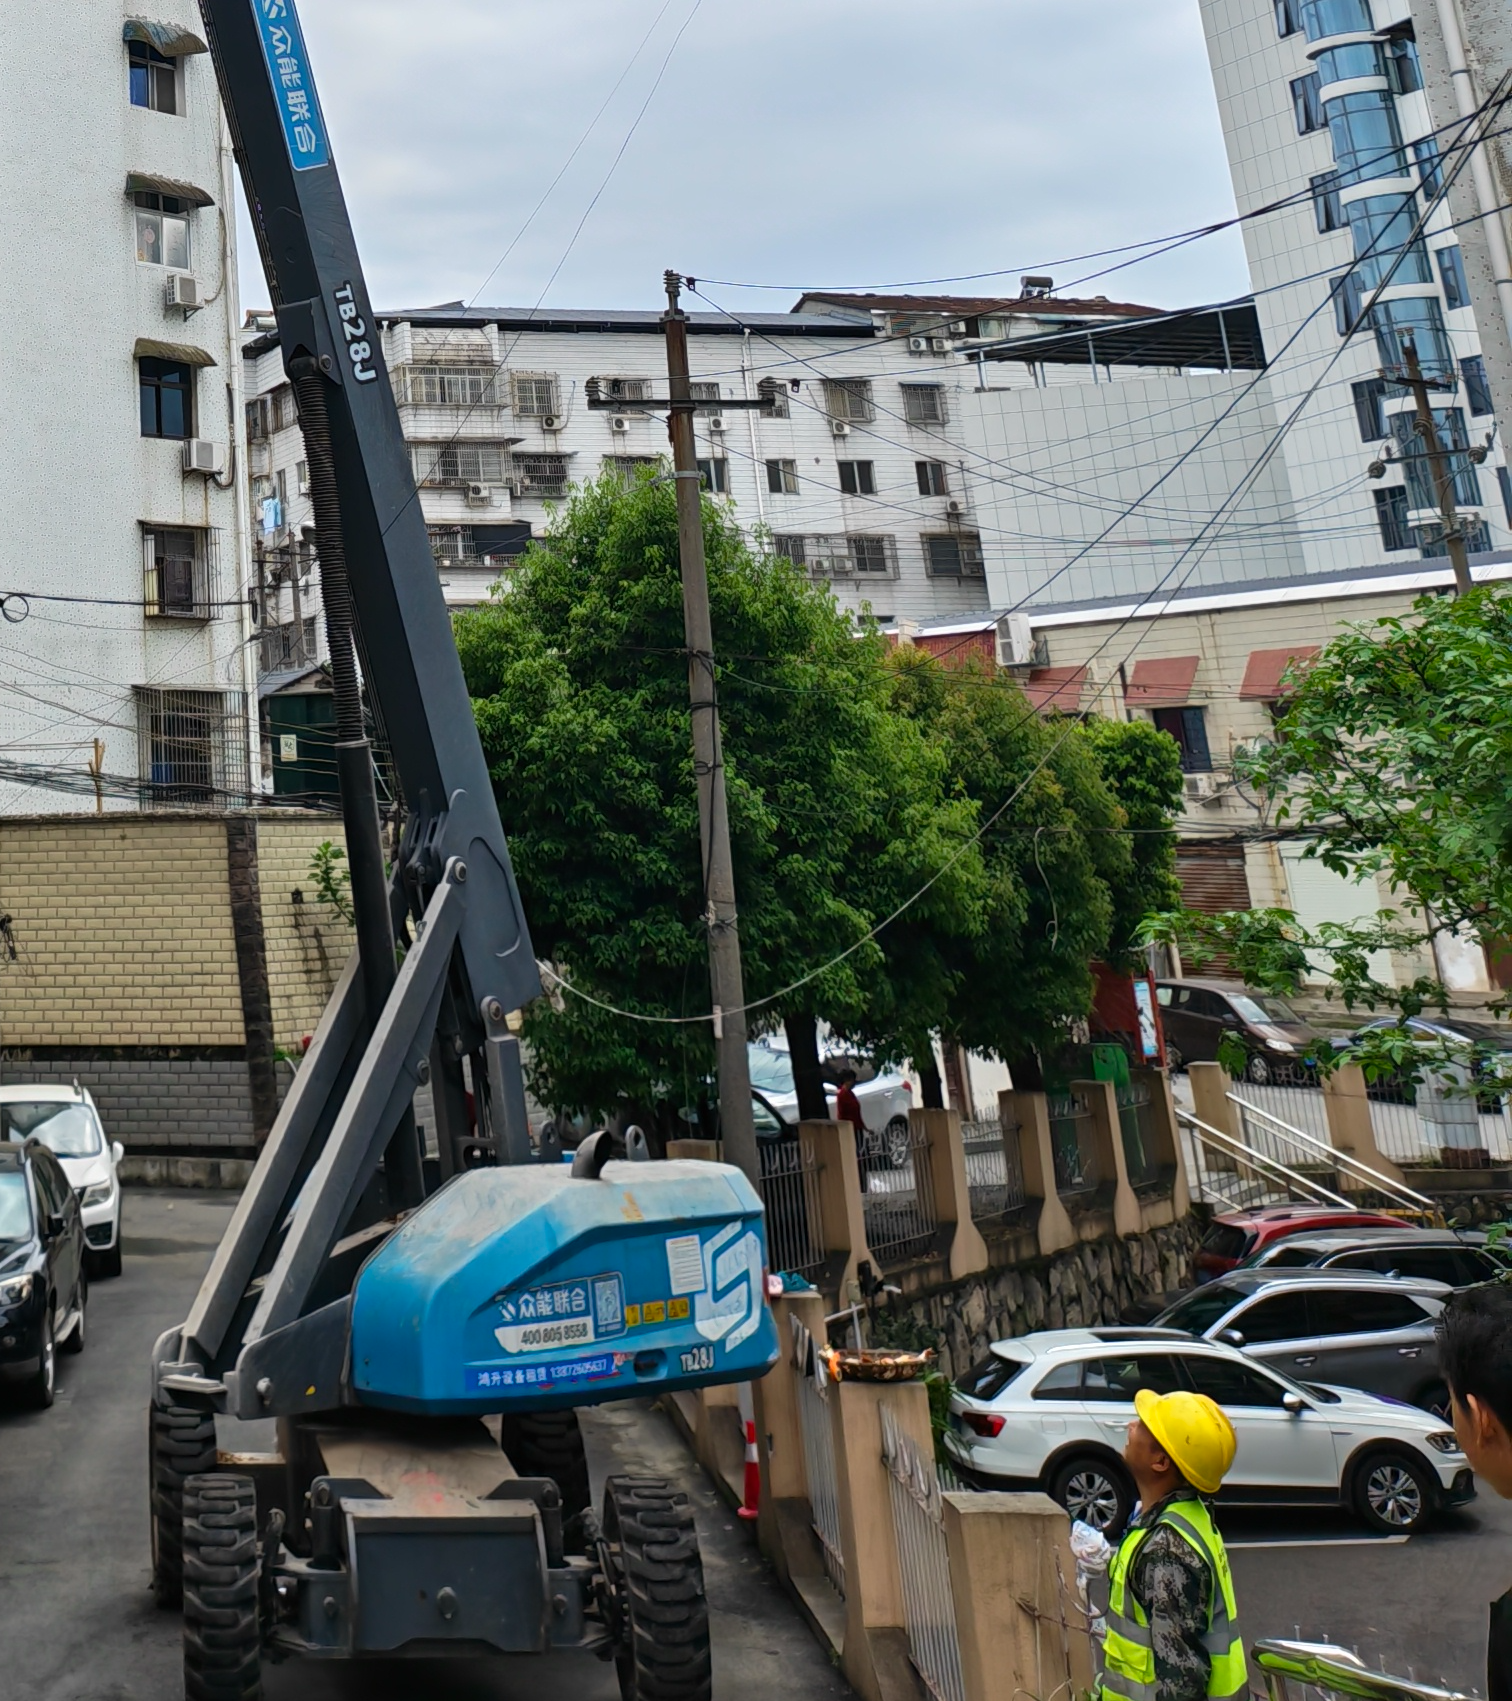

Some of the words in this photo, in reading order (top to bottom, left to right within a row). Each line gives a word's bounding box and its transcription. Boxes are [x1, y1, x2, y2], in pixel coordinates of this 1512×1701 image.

[268, 24, 316, 154] 众能联合
[335, 281, 378, 383] TB28J
[518, 1287, 586, 1319] 众能联合
[521, 1328, 542, 1345] 400
[680, 1345, 715, 1372] TB28J
